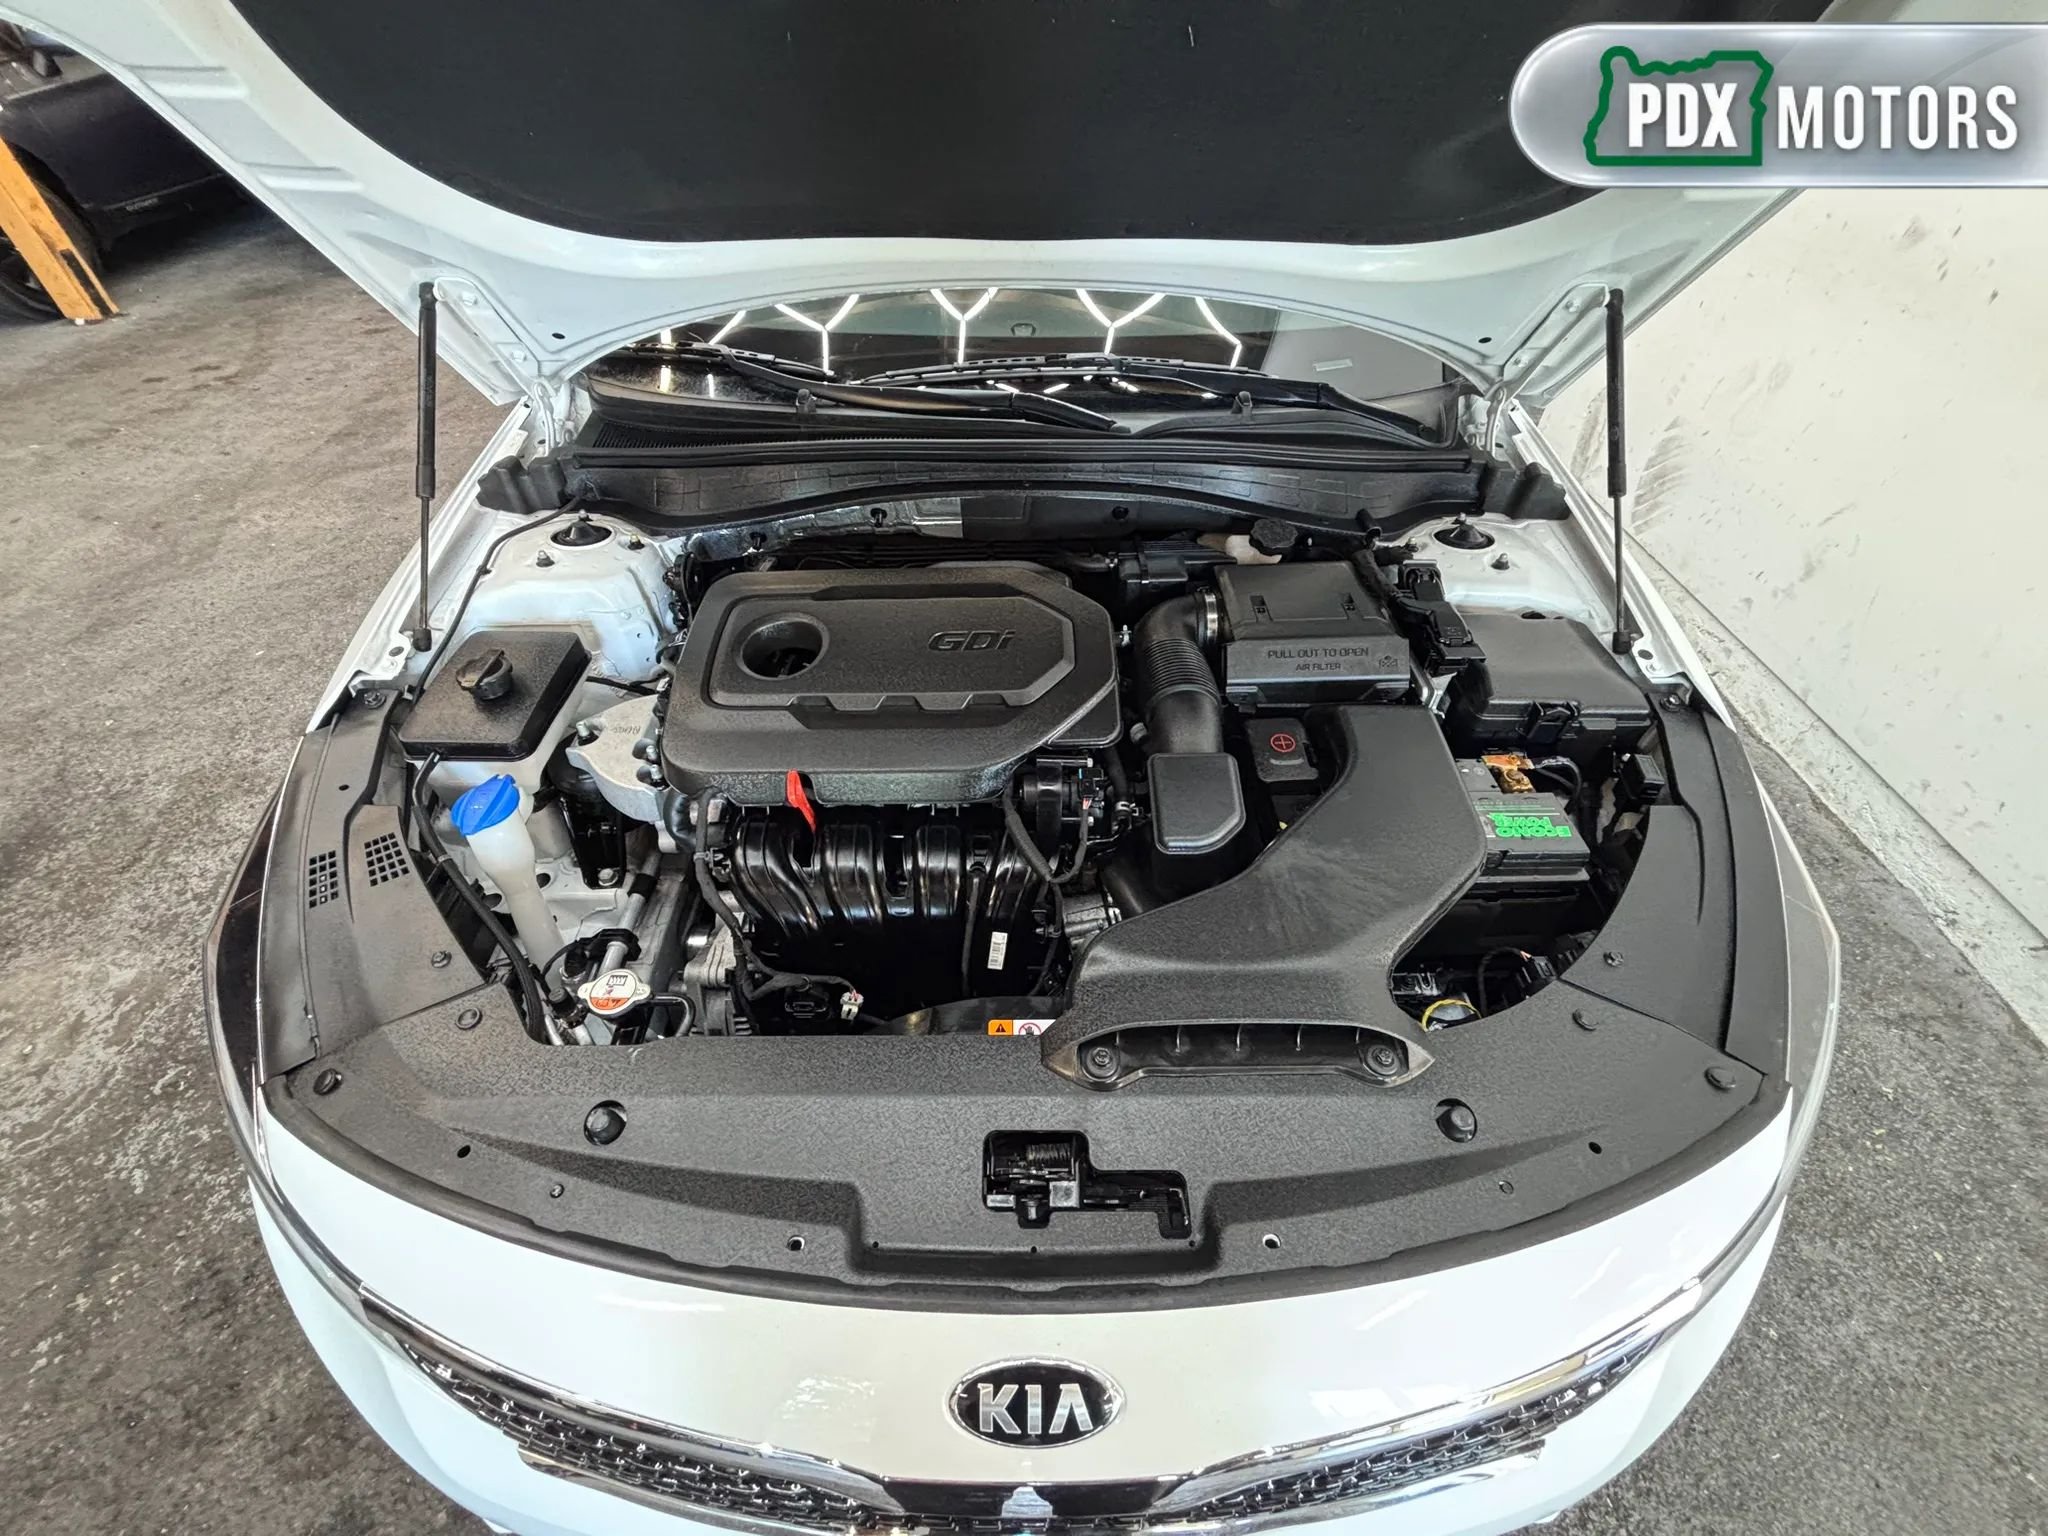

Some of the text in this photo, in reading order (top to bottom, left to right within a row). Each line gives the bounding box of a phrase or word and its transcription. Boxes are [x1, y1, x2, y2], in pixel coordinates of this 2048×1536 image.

[928, 629, 1016, 651] GDi
[1267, 647, 1369, 659] PULL OUT TO OPEN
[1295, 663, 1341, 671] AIR FILTER
[1488, 813, 1553, 827] POWER
[1496, 826, 1572, 837] ECONO
[977, 1383, 1094, 1434] KIA
